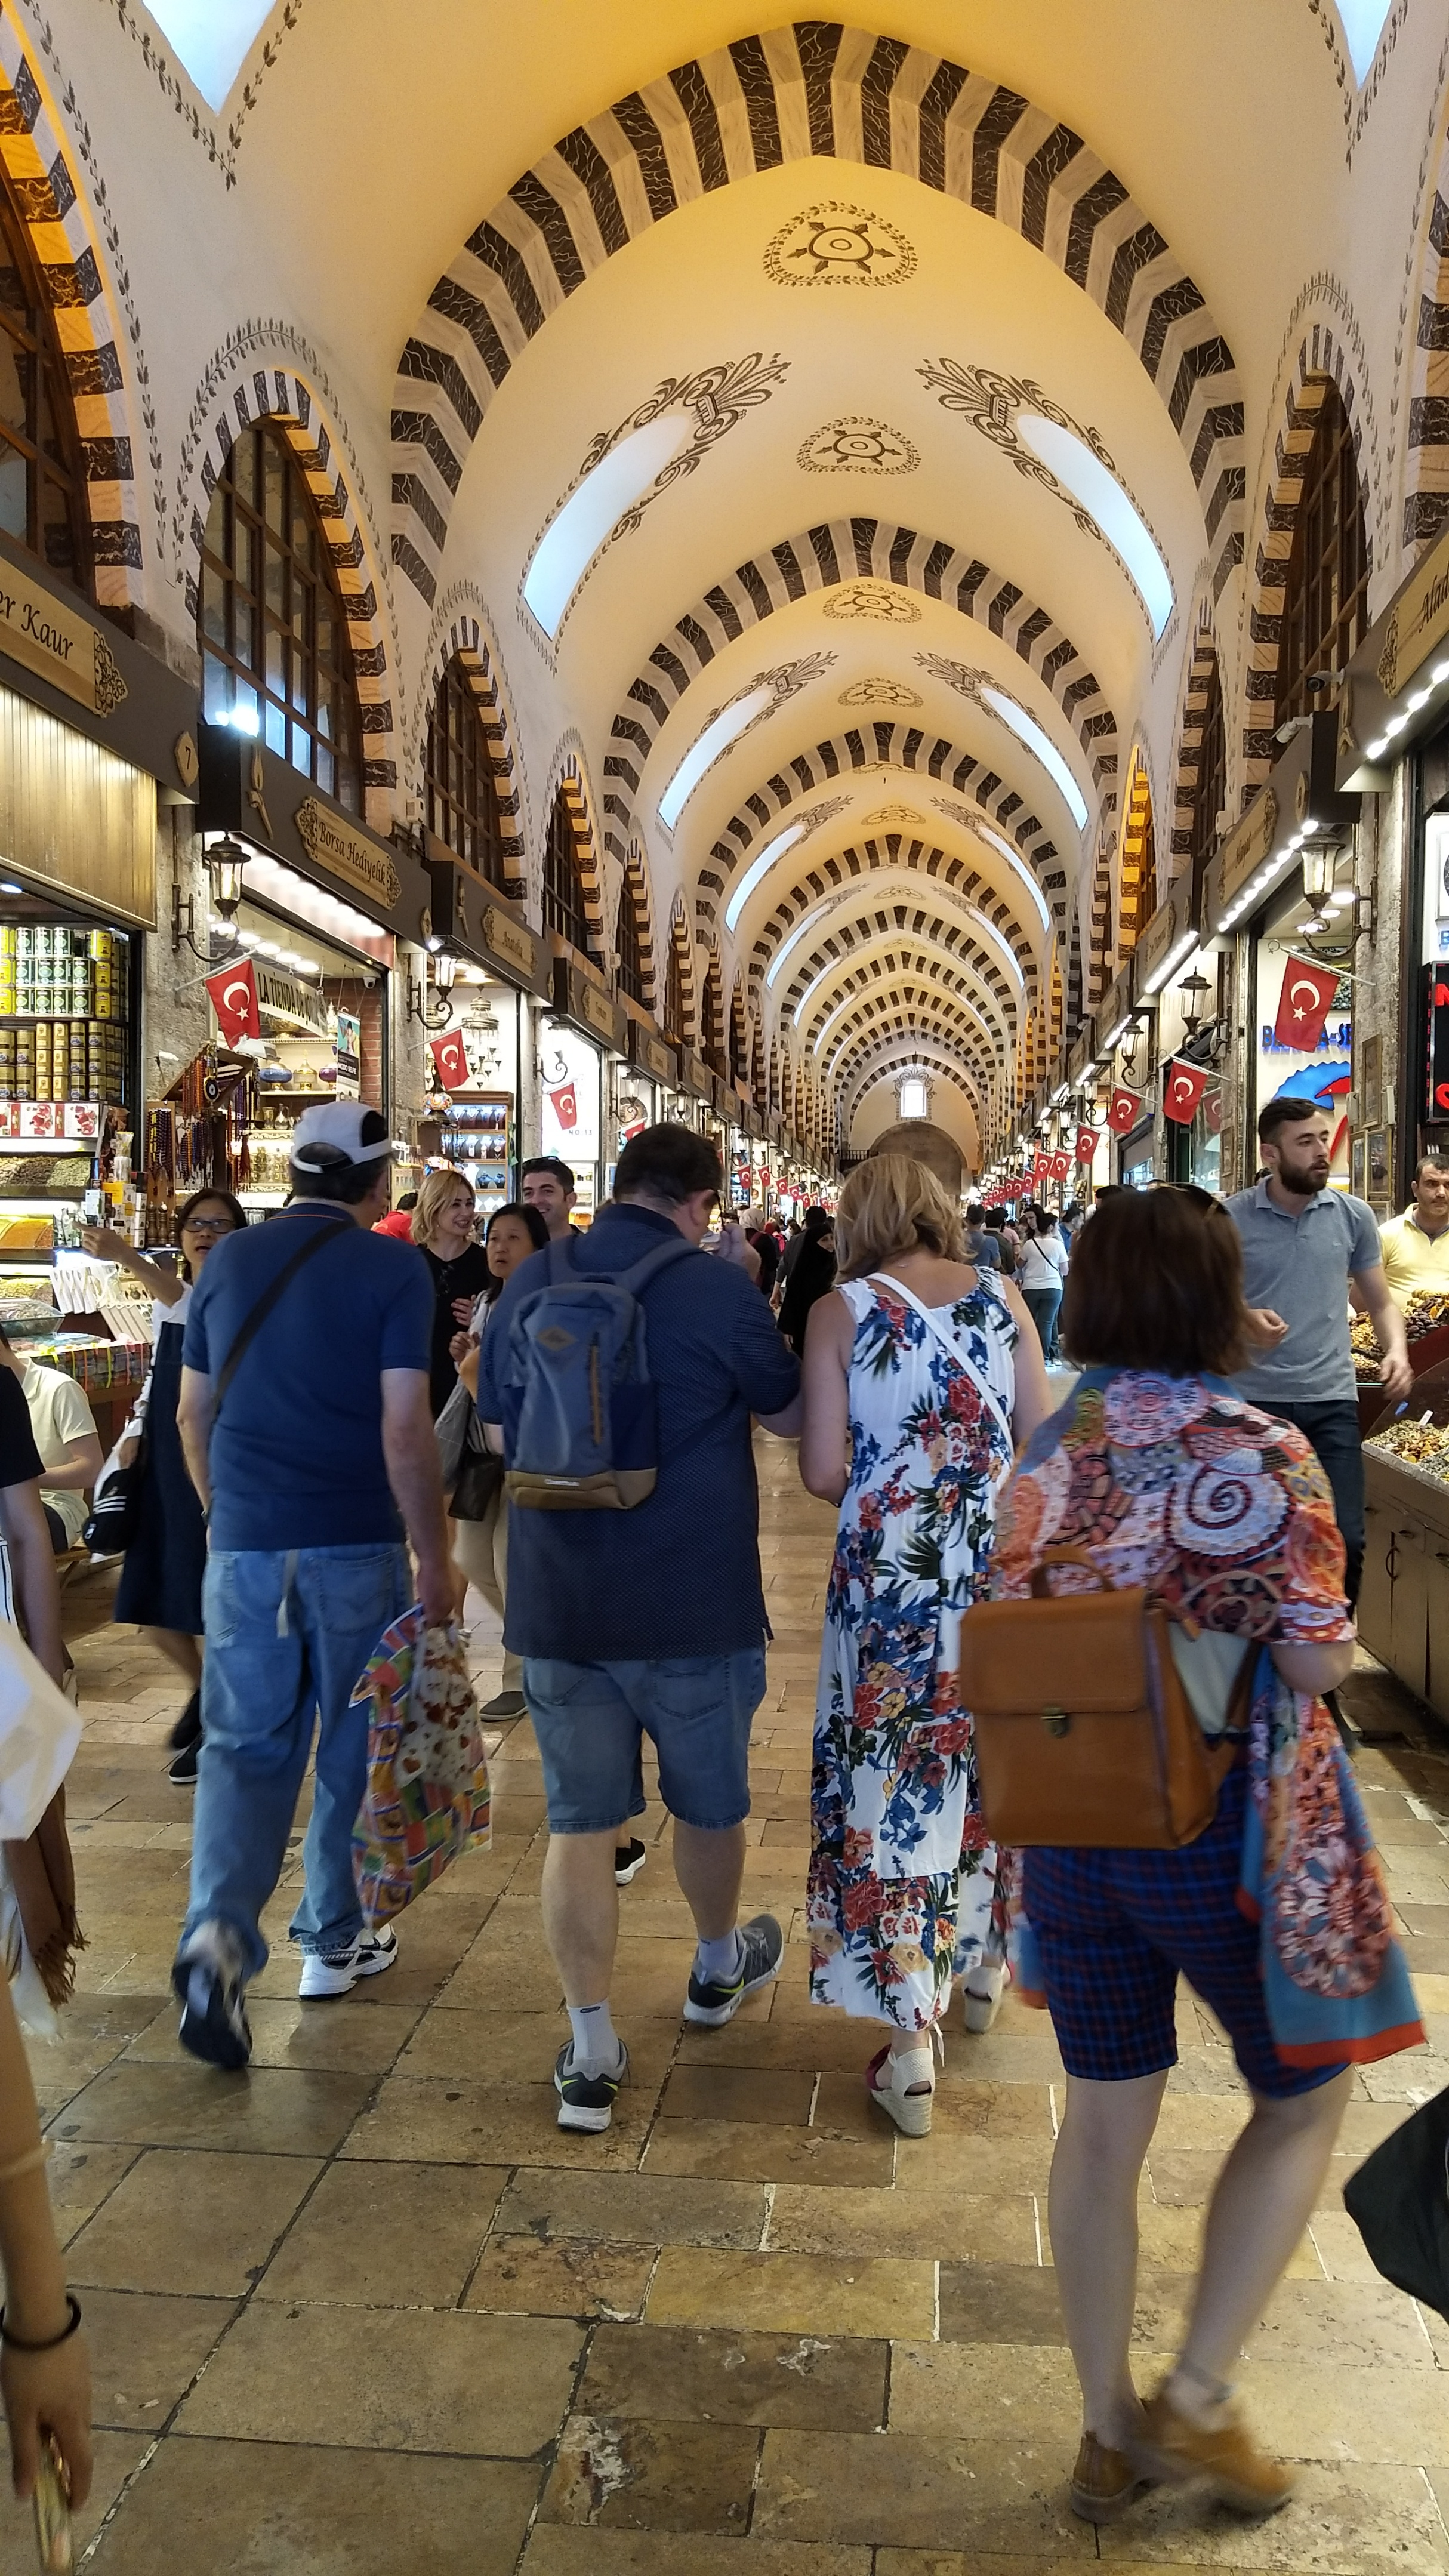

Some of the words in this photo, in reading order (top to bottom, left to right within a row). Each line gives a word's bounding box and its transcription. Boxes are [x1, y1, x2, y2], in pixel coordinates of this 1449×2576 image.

[21, 604, 73, 660] Kaur
[185, 745, 191, 770] 7
[319, 821, 345, 857] Borsa
[347, 842, 386, 886] Hediyelik
[258, 972, 270, 1005] LA
